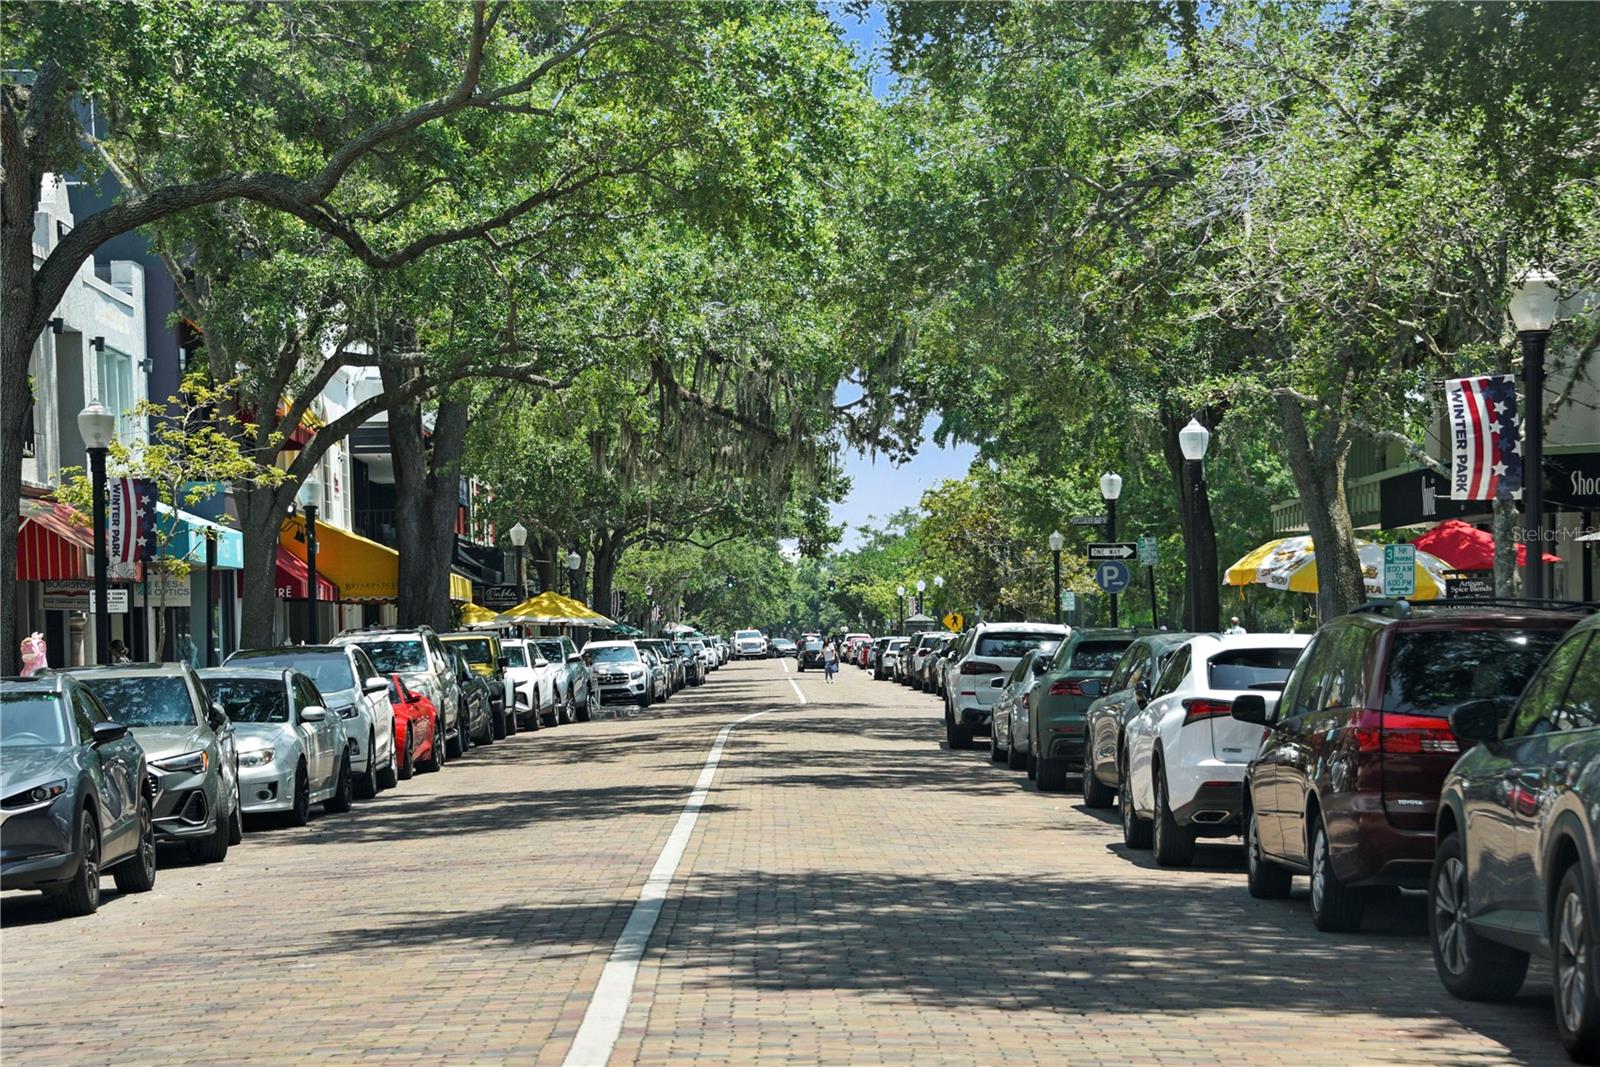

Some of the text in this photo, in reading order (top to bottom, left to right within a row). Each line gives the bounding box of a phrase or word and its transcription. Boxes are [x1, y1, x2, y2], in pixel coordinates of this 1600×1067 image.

[1450, 388, 1467, 492] WINTER PARK
[112, 484, 121, 557] WINTER PARK
[1093, 548, 1104, 556] ONE
[1386, 549, 1393, 560] 3
[155, 580, 178, 588] EES
[1102, 565, 1119, 587] P
